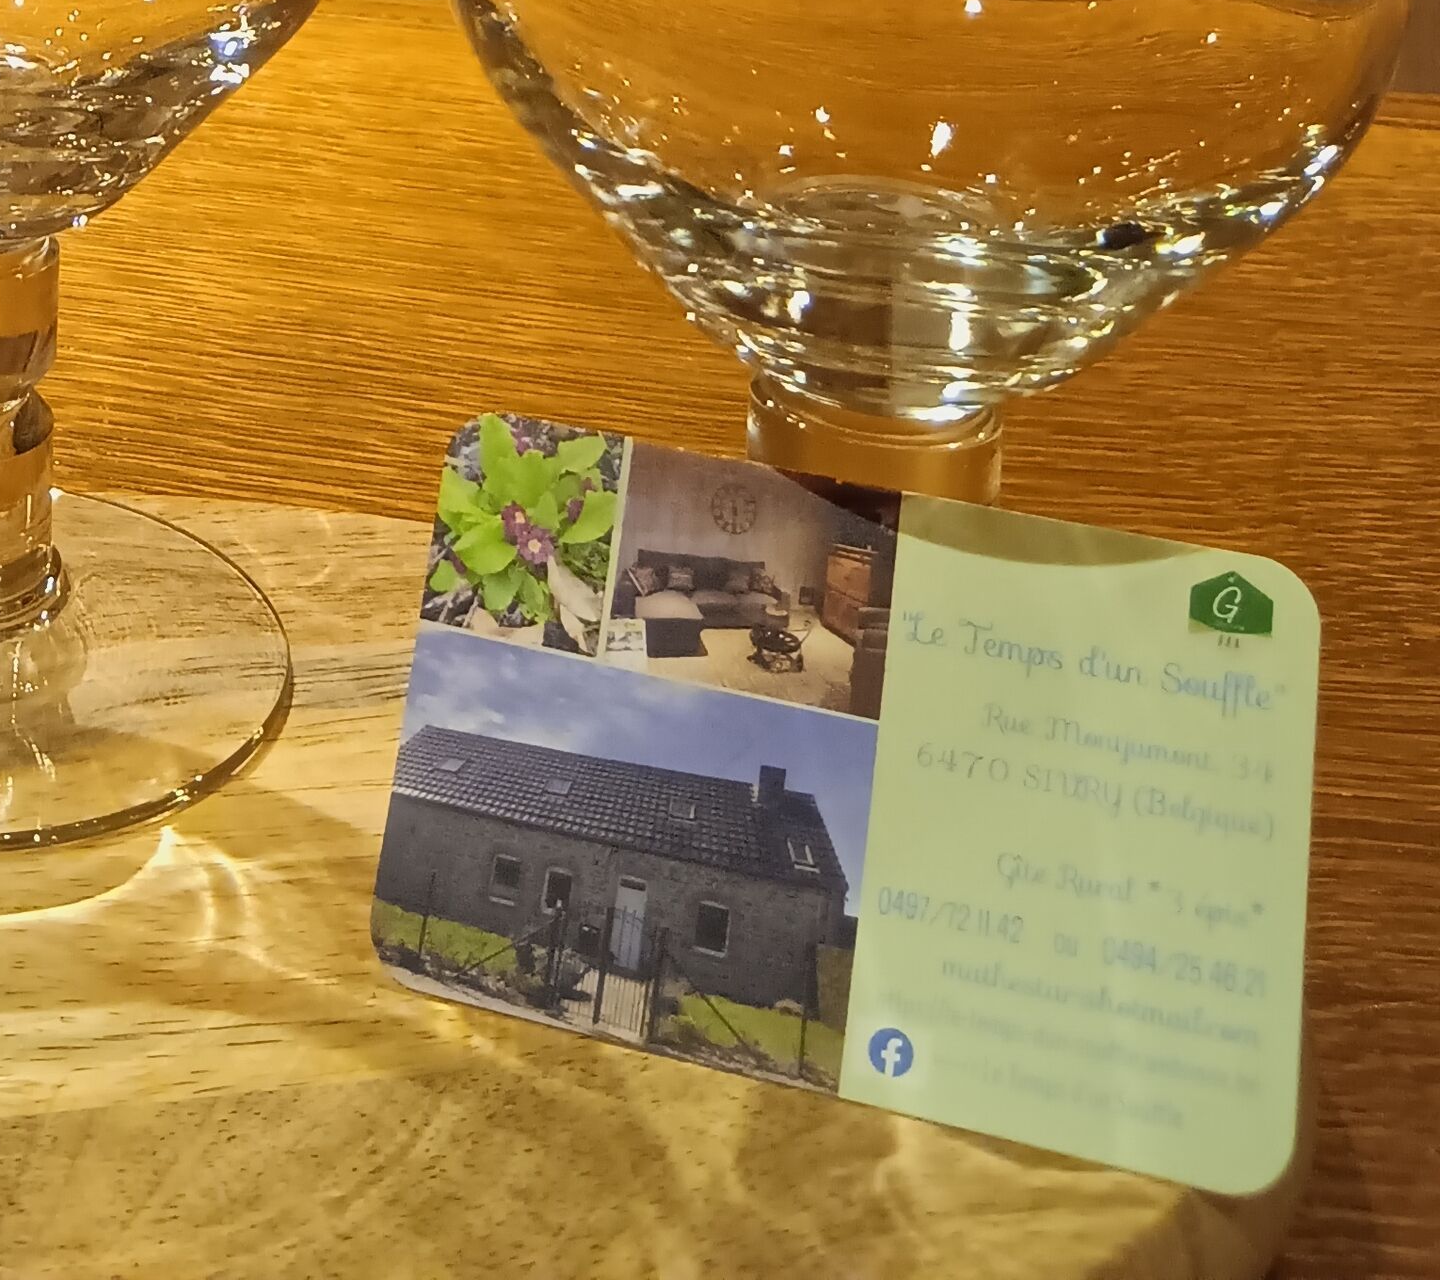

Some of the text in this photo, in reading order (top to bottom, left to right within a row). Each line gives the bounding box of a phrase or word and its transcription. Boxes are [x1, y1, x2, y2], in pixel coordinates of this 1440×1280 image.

[1213, 586, 1242, 624] G
[959, 618, 1063, 678] Temps
[1079, 645, 1142, 684] d'un
[917, 742, 1010, 782] 6470
